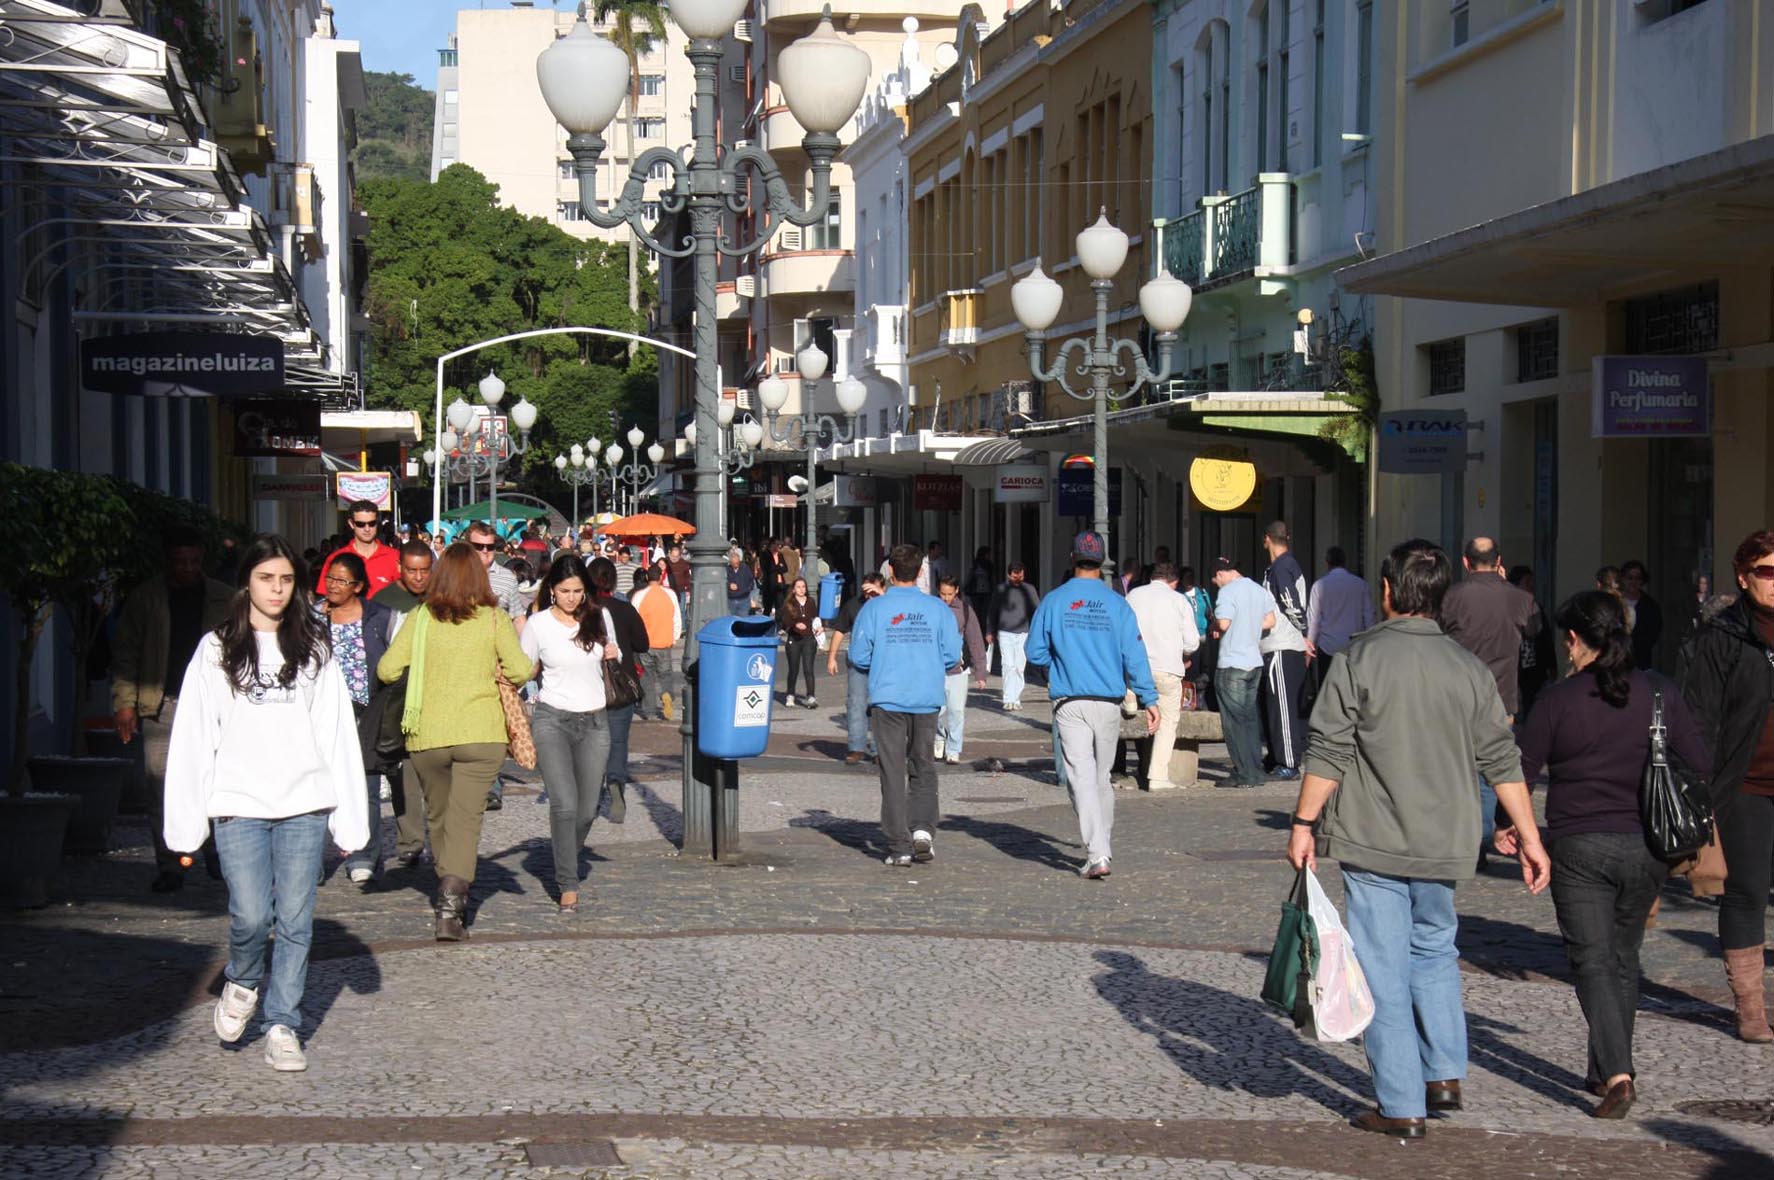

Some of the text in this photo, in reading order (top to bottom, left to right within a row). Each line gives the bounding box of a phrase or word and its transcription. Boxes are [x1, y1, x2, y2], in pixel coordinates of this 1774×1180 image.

[92, 353, 275, 375] magazineluiza
[1628, 369, 1681, 387] Divina
[1610, 391, 1699, 411] Perfumaria
[1001, 476, 1044, 486] CARIOCA
